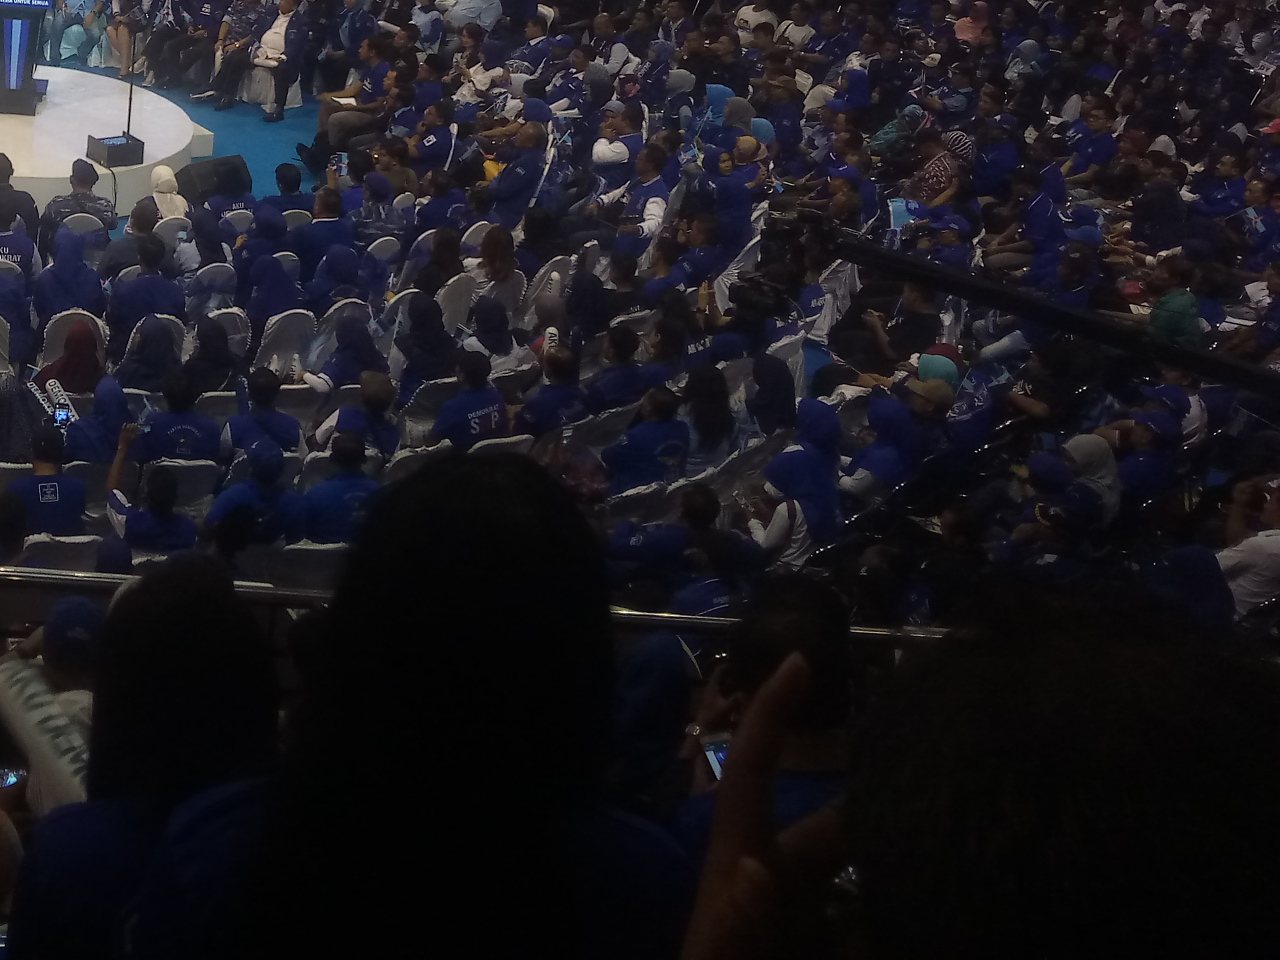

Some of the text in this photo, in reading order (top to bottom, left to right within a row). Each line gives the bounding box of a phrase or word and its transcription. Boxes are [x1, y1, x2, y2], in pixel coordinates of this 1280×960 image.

[31, 0, 49, 7] SEMUA
[232, 202, 245, 210] AKU
[467, 403, 500, 420] DEMOKRAT
